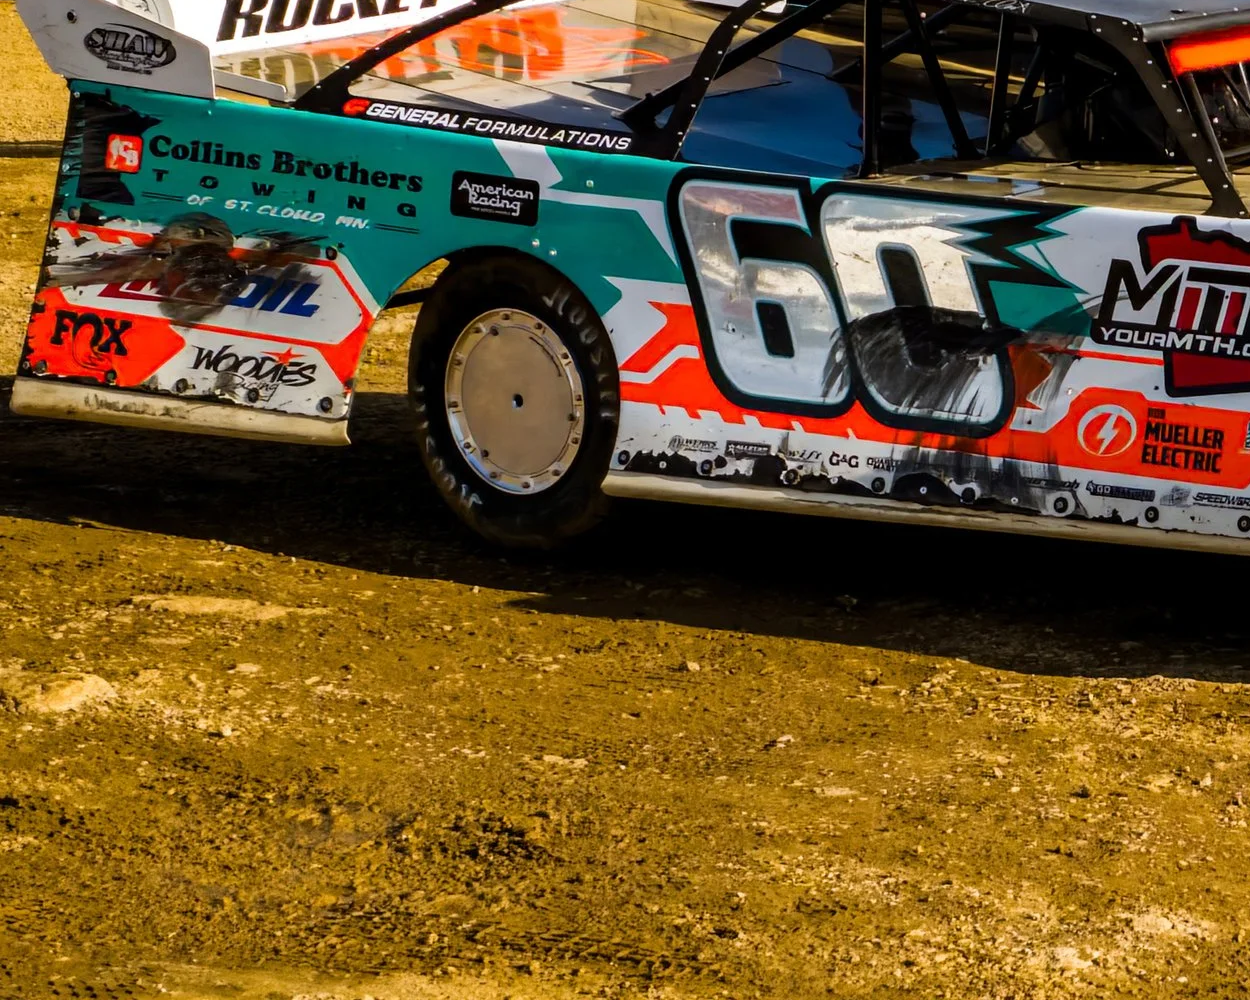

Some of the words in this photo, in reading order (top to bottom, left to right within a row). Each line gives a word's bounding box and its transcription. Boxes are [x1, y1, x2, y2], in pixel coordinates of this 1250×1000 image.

[365, 102, 461, 129] GENERAL
[461, 116, 632, 150] FORMULATIONS
[149, 134, 261, 171] Collins
[271, 149, 424, 193] Brothers
[151, 168, 417, 218] TOWING
[187, 194, 213, 206] OF
[224, 199, 252, 212] ST.
[458, 178, 534, 200] American
[468, 192, 522, 217] Racing
[50, 310, 133, 357] FOX
[188, 343, 319, 386] WOODIES
[1144, 420, 1225, 450] MUELLER
[787, 449, 823, 460] wift
[828, 451, 860, 468] G&G
[1141, 443, 1223, 474] ELECTRIC
